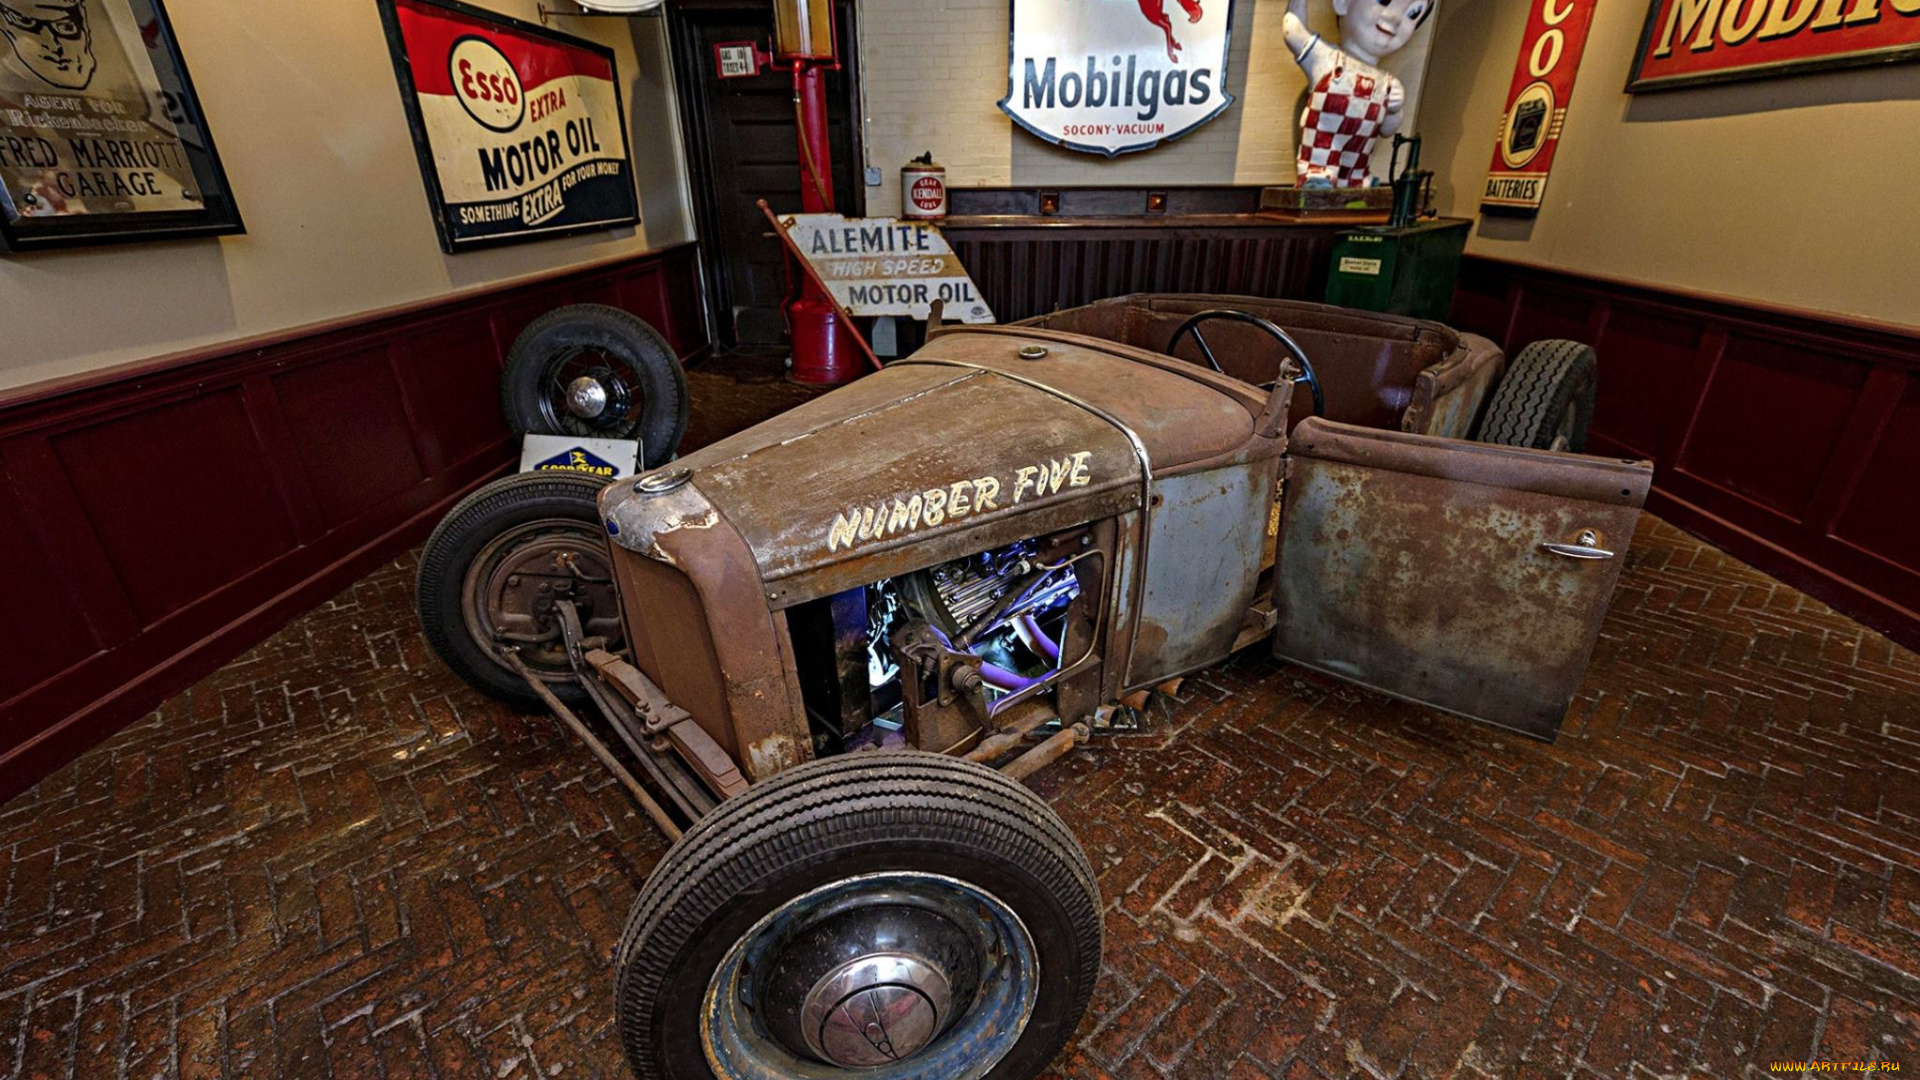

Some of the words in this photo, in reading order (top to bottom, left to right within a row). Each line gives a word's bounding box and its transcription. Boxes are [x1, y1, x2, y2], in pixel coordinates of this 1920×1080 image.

[458, 59, 518, 106] Esso
[1023, 54, 1212, 121] Mobilgas
[24, 94, 82, 112] AGENT
[88, 98, 127, 115] FOR
[530, 87, 566, 123] EXTRA
[0, 136, 59, 168] FRED
[69, 138, 183, 169] MARRIOTT
[478, 129, 564, 192] MOTOR
[566, 117, 600, 157] OIL
[57, 172, 163, 198] GARAGE
[460, 201, 520, 225] SOMETHING
[522, 179, 564, 225] EXTRA
[563, 171, 576, 191] FOR
[577, 163, 596, 183] YOUR
[597, 162, 620, 175] MONEY
[912, 188, 943, 200] KENDALL
[1485, 179, 1539, 200] BATTERIES
[812, 226, 930, 254] ALEMITE
[833, 260, 876, 277] HIGH
[882, 258, 944, 276] SPEED
[848, 284, 928, 305] MOTOR
[938, 282, 975, 303] OIL
[828, 475, 1000, 552] NUMBER
[1013, 451, 1093, 502] FIVE
